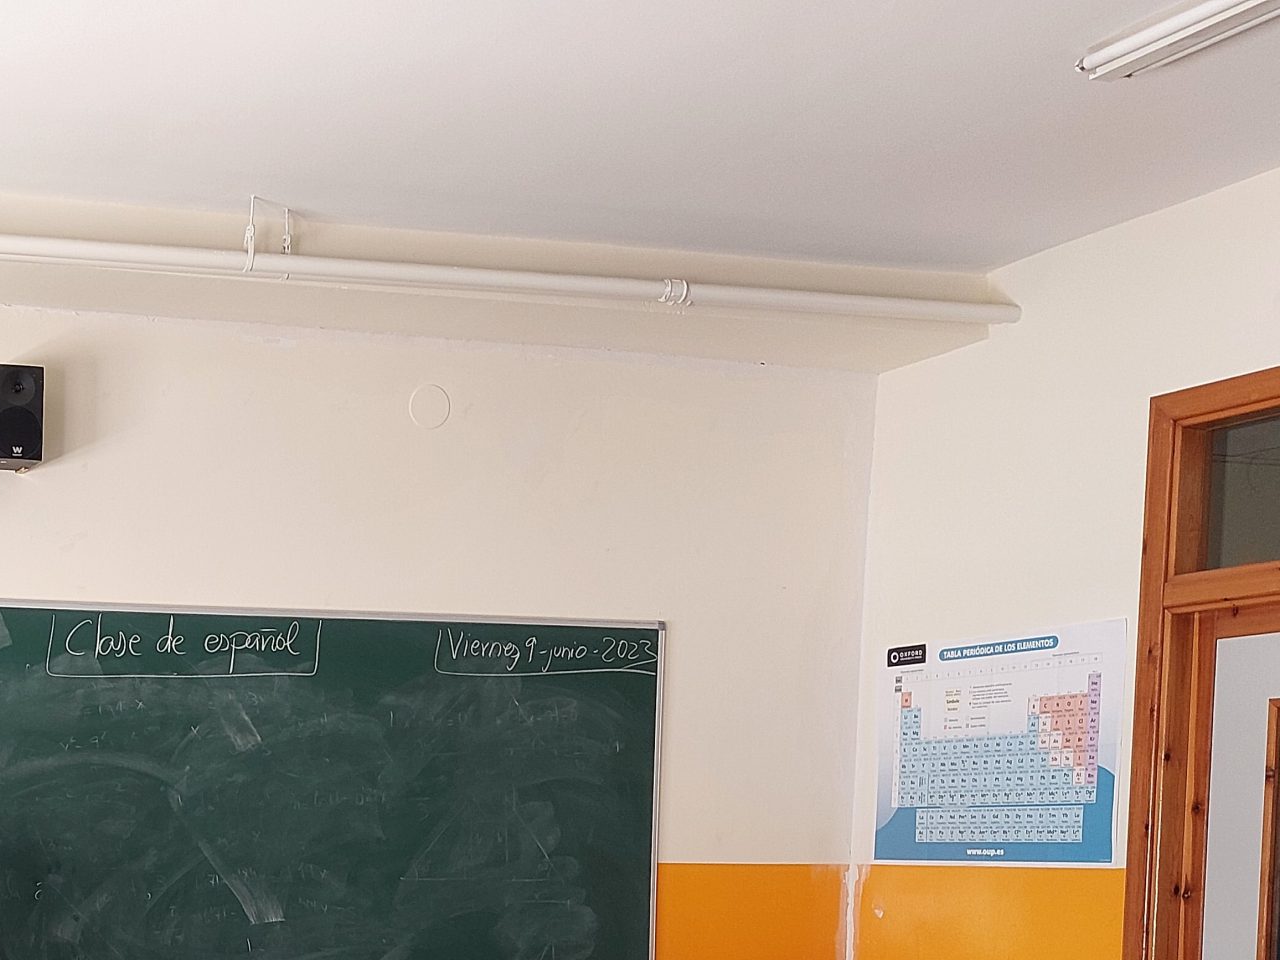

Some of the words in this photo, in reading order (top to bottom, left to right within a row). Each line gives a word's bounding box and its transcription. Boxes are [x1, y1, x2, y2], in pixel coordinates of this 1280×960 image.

[64, 612, 142, 658] Clase
[156, 614, 187, 654] de
[204, 621, 301, 674] español
[943, 650, 962, 659] TABLA
[963, 646, 994, 658] PERIÓDICA
[994, 645, 1003, 653] DE
[1004, 644, 1016, 652] LOS
[1017, 638, 1054, 650] ELEMENTOS
[899, 649, 923, 658] OXFORD
[966, 848, 1005, 856] www.oup.es
